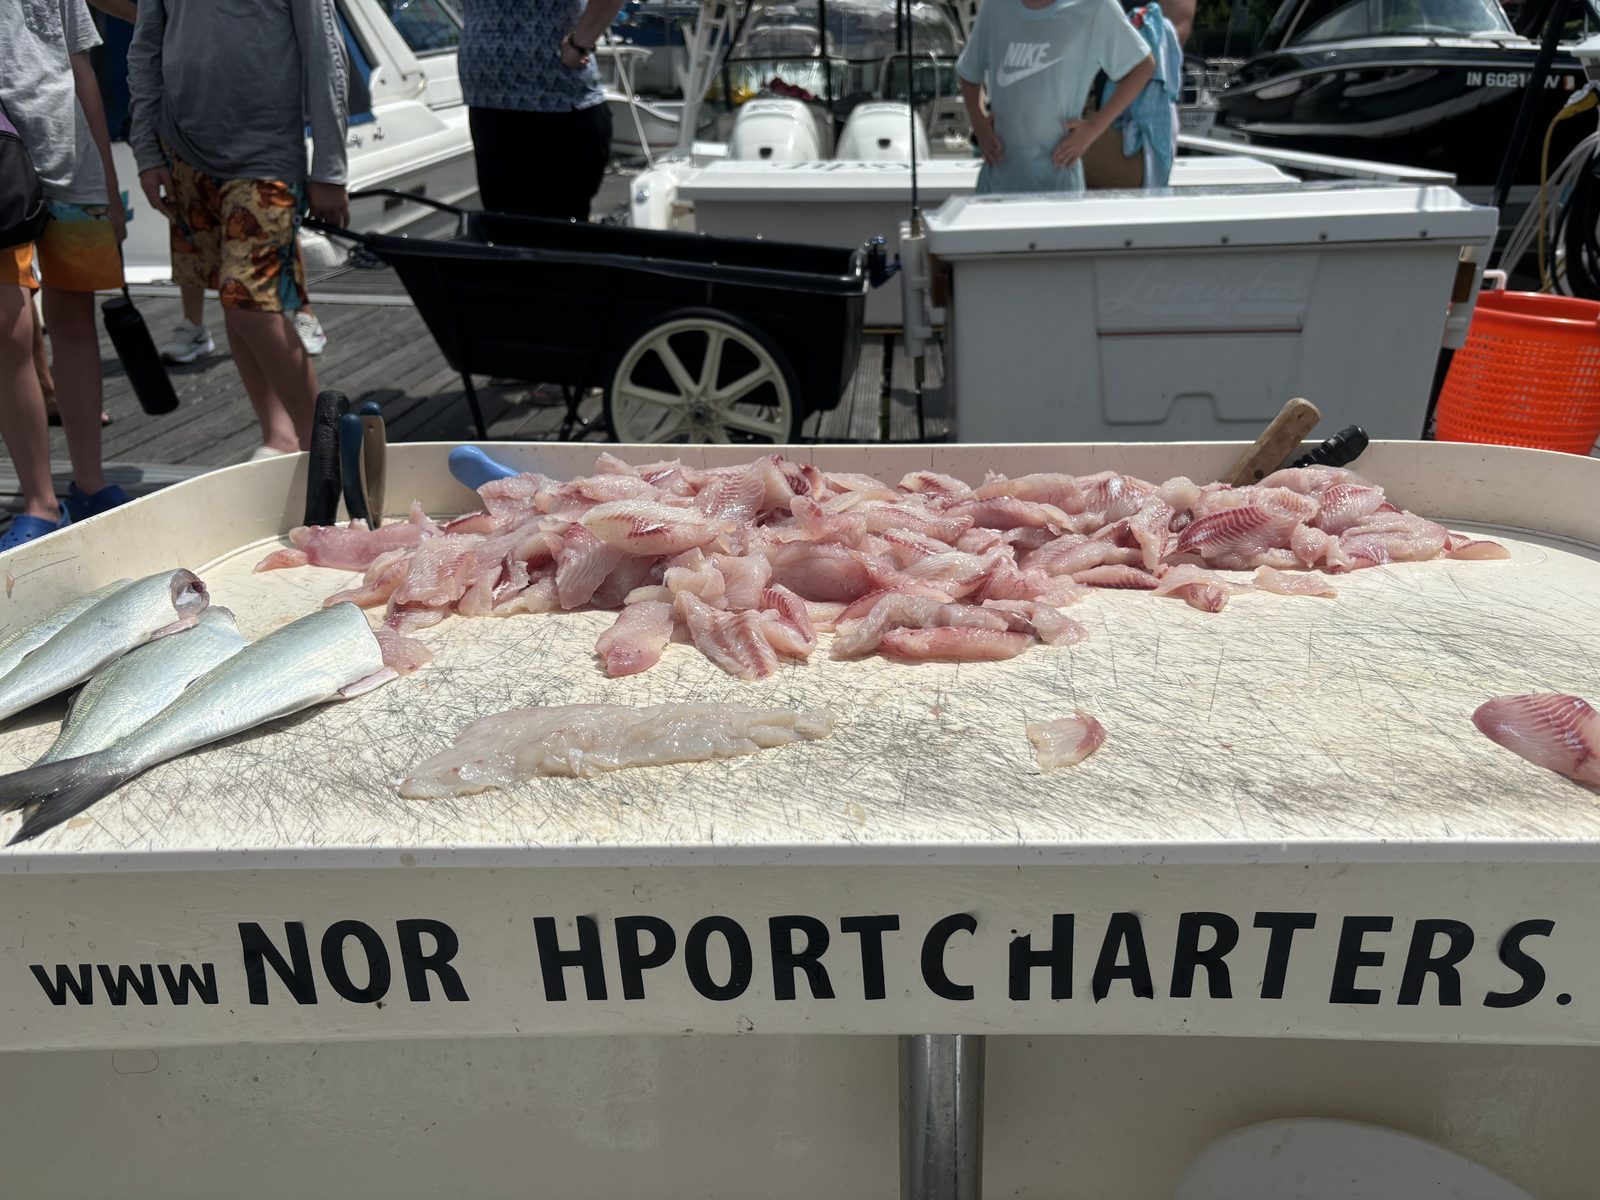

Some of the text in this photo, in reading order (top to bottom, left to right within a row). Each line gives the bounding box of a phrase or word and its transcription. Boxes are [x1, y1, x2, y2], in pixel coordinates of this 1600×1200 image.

[1004, 42, 1051, 67] NIKE
[1466, 71, 1482, 86] IN
[1485, 72, 1526, 88] 6021
